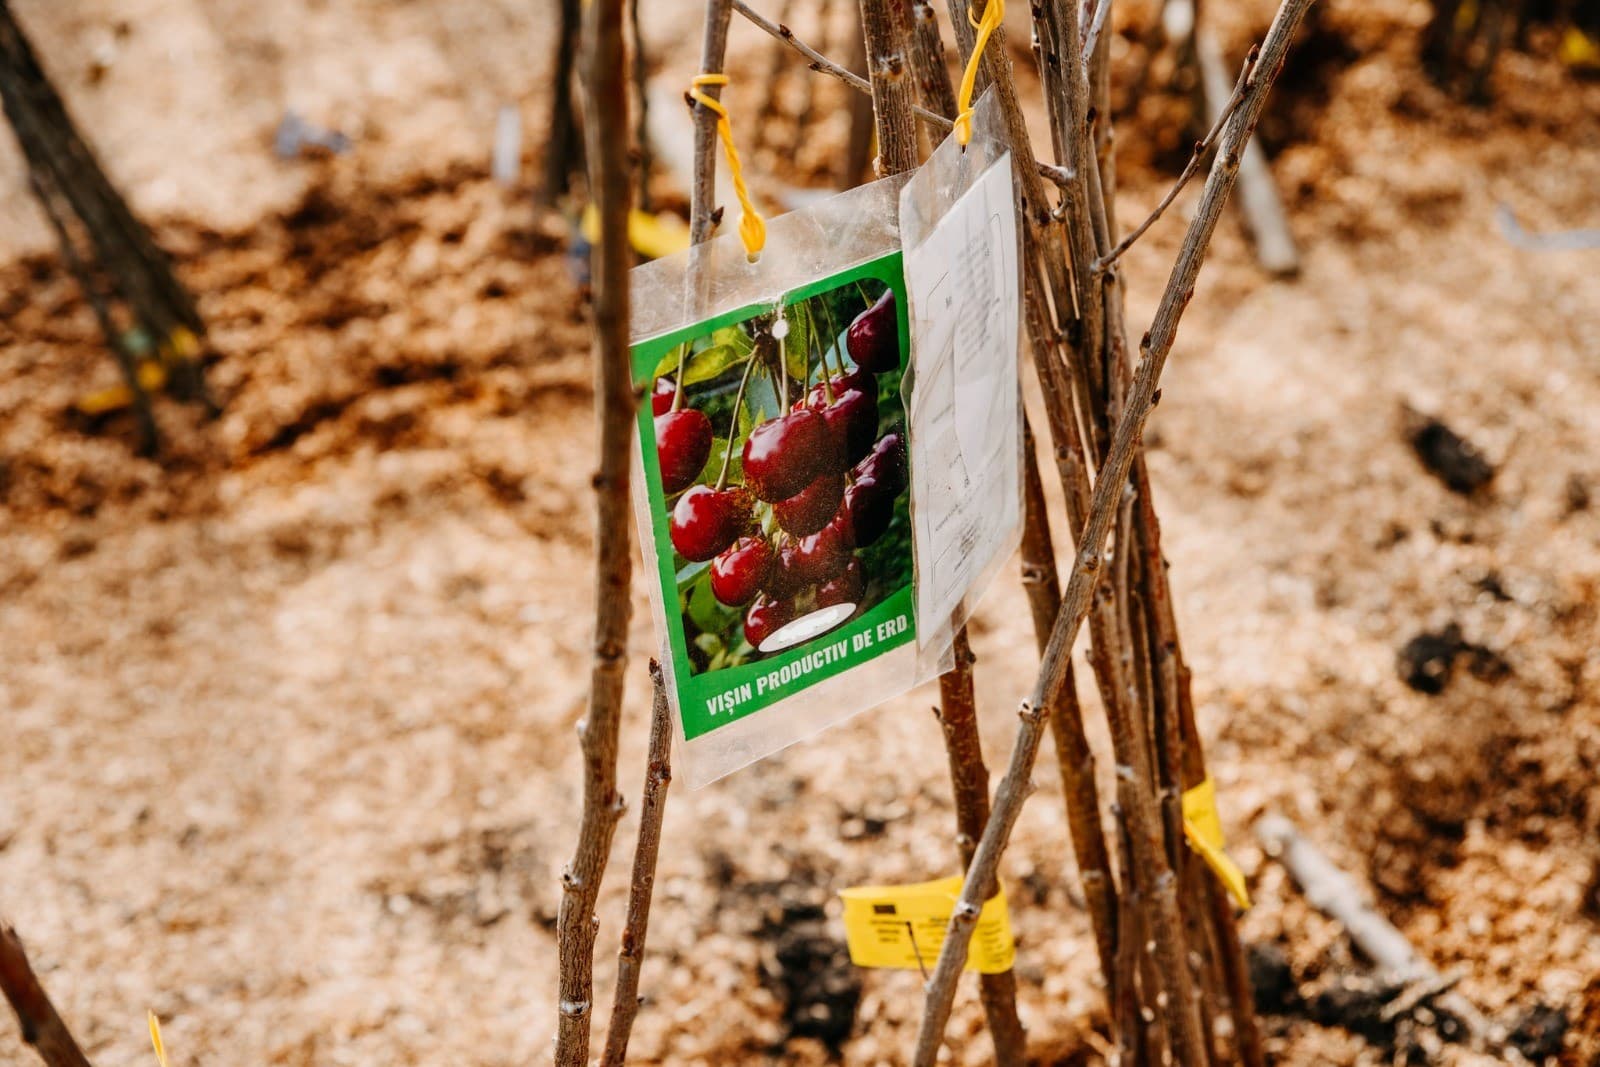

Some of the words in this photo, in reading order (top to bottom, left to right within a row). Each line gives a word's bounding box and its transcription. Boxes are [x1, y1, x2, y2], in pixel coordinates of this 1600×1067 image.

[756, 639, 848, 696] PRODUCTIV
[852, 629, 873, 653] DE
[876, 614, 907, 642] ERD
